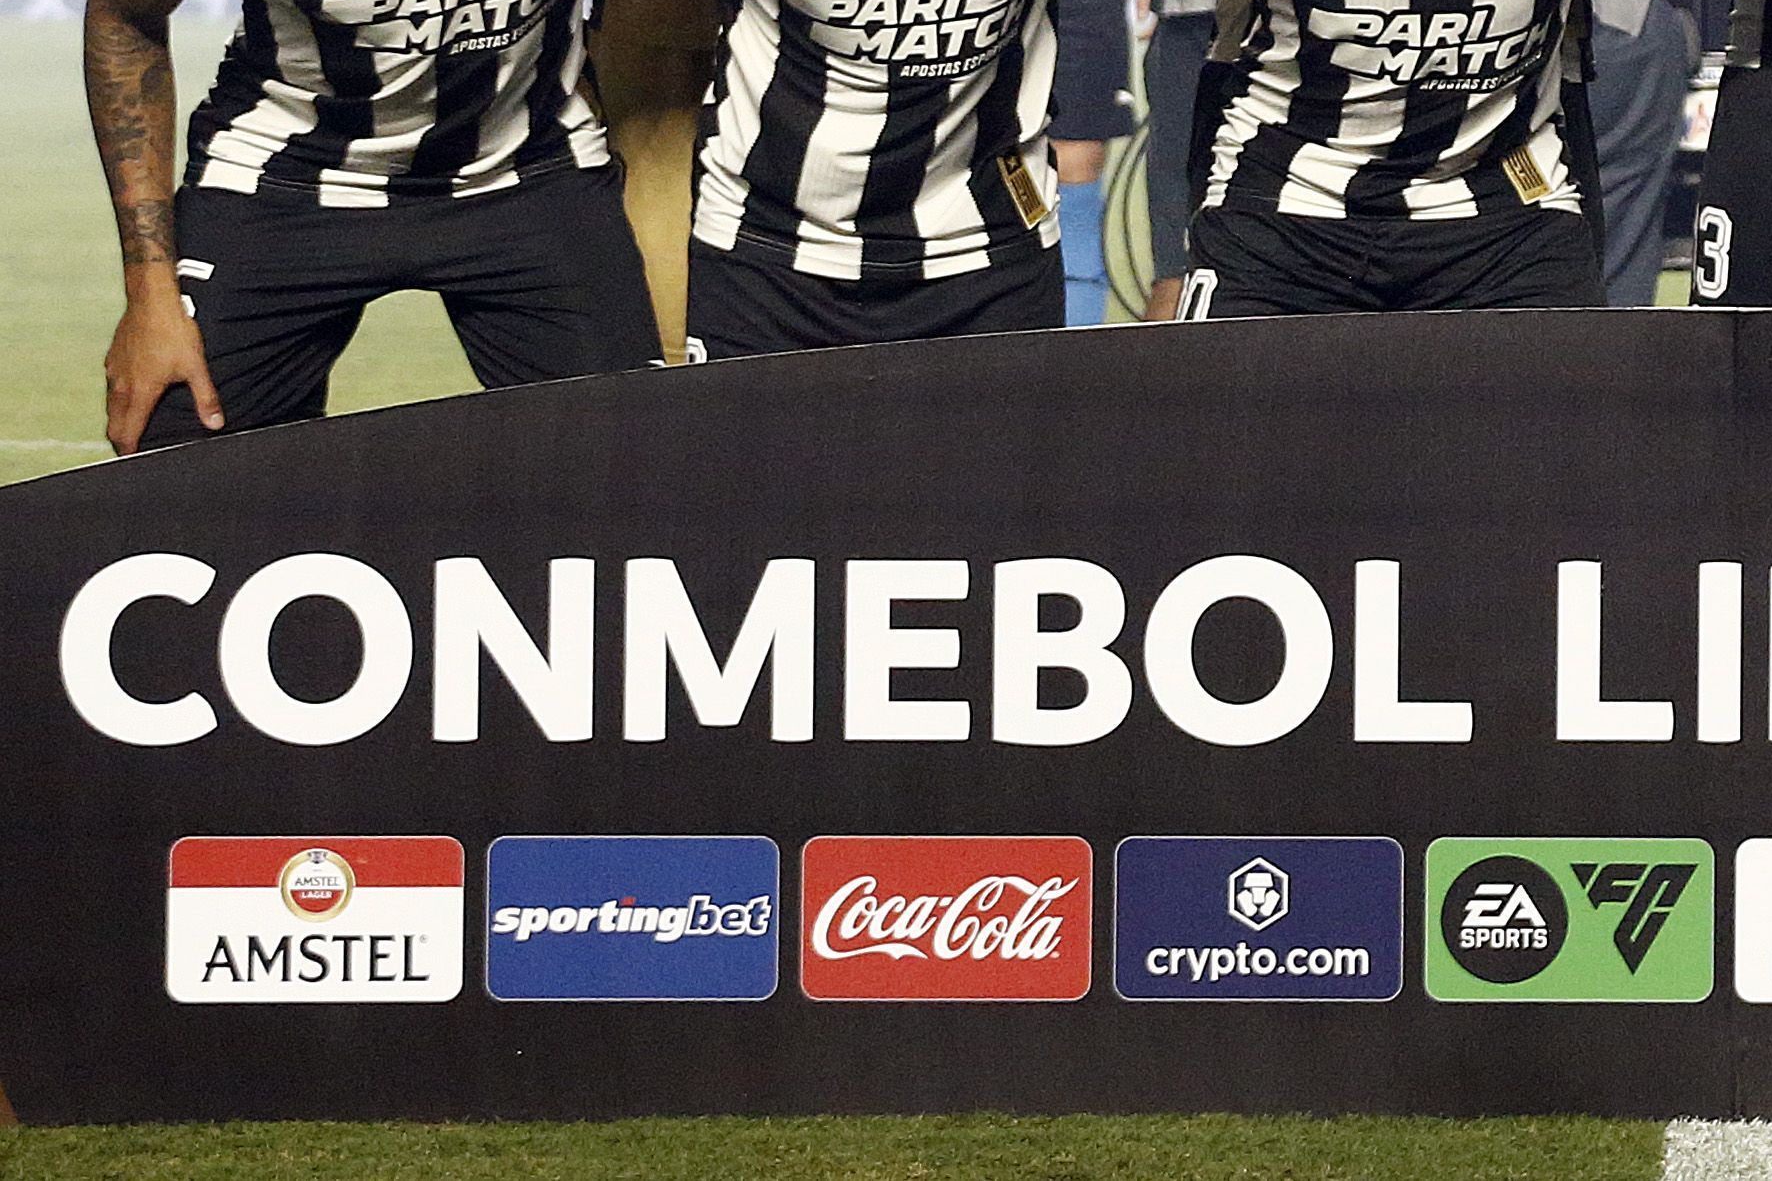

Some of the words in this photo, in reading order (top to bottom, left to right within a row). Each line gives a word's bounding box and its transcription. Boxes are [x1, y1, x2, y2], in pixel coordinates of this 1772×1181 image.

[449, 32, 510, 55] APOSTAS
[1308, 7, 1489, 48] PARI
[900, 61, 962, 78] APOSTAS
[58, 552, 1475, 748] CONMEBOL
[294, 876, 340, 887] AMSTEL
[491, 894, 772, 943] sportingbet
[811, 874, 1080, 961] Coca-Cola
[1462, 883, 1547, 926] EA
[201, 933, 431, 984] AMSTEL
[1459, 927, 1549, 950] SPORTS
[1146, 942, 1370, 983] crypto.com
